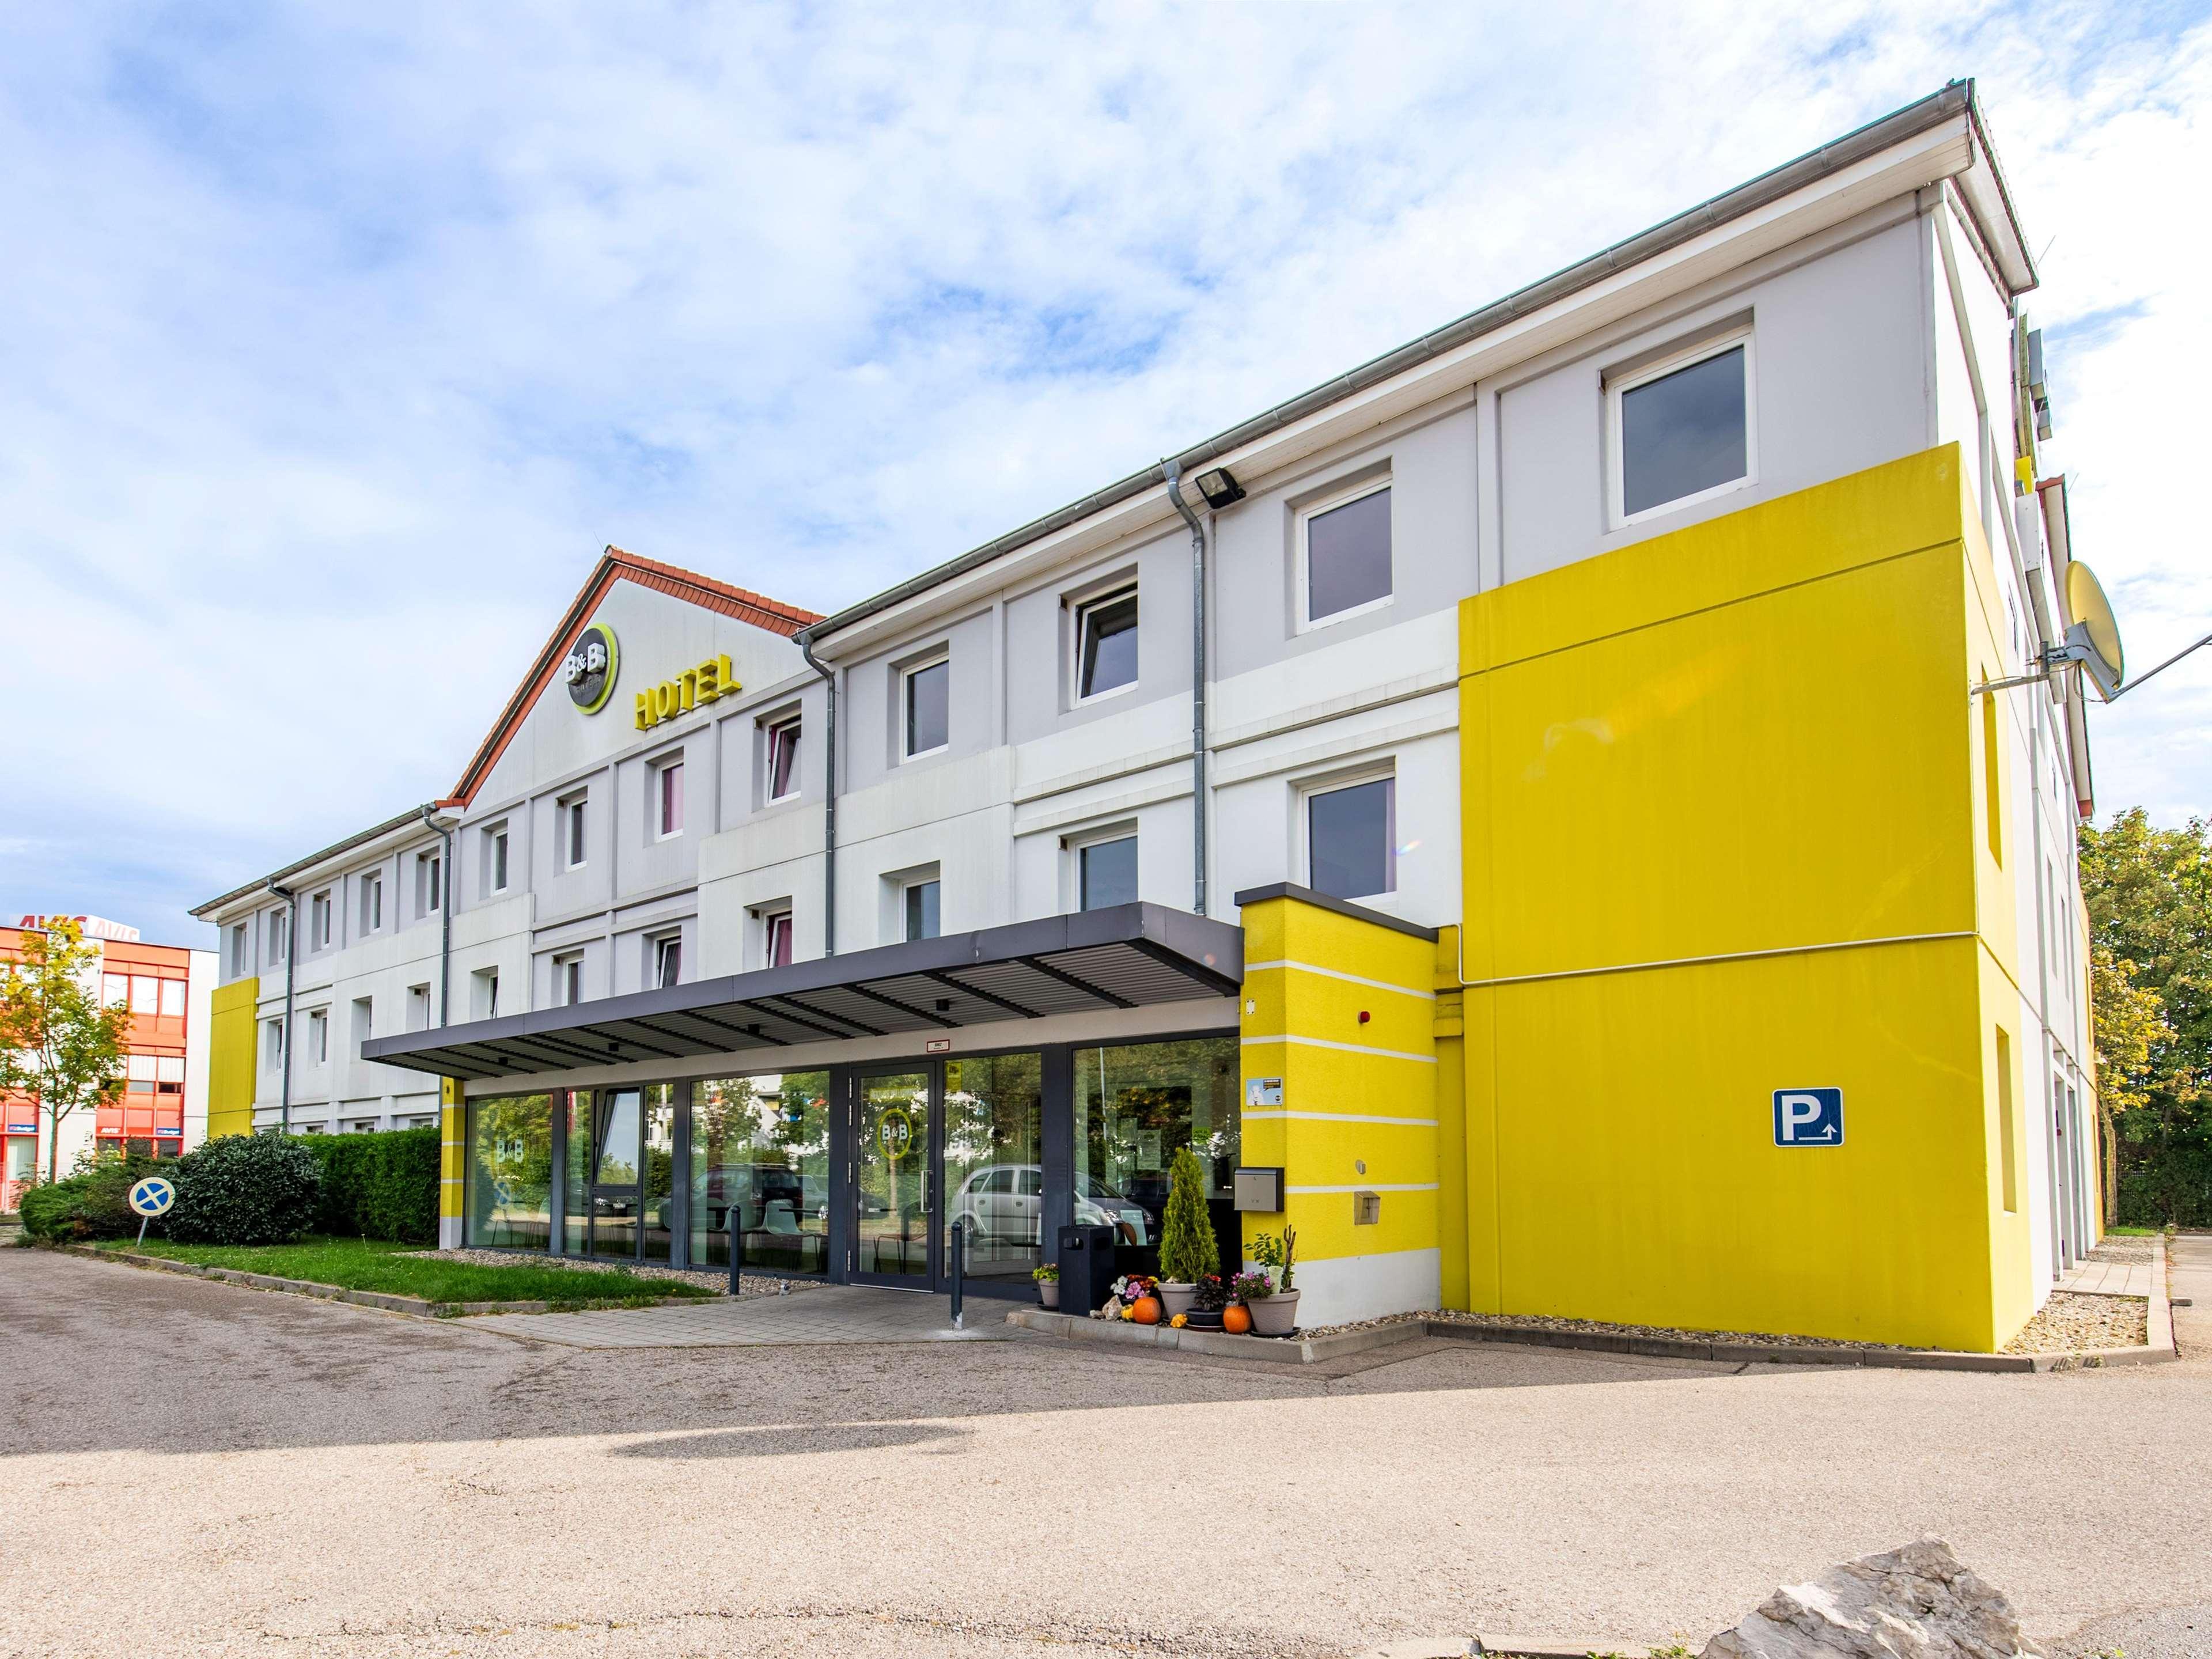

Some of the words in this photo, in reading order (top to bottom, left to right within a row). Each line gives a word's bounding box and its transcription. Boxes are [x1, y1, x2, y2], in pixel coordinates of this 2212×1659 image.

[565, 642, 605, 684] B&B
[635, 654, 742, 731] HOTEL
[882, 1124, 908, 1140] B&B
[1781, 1094, 1821, 1141] P
[497, 1139, 524, 1163] B&B
